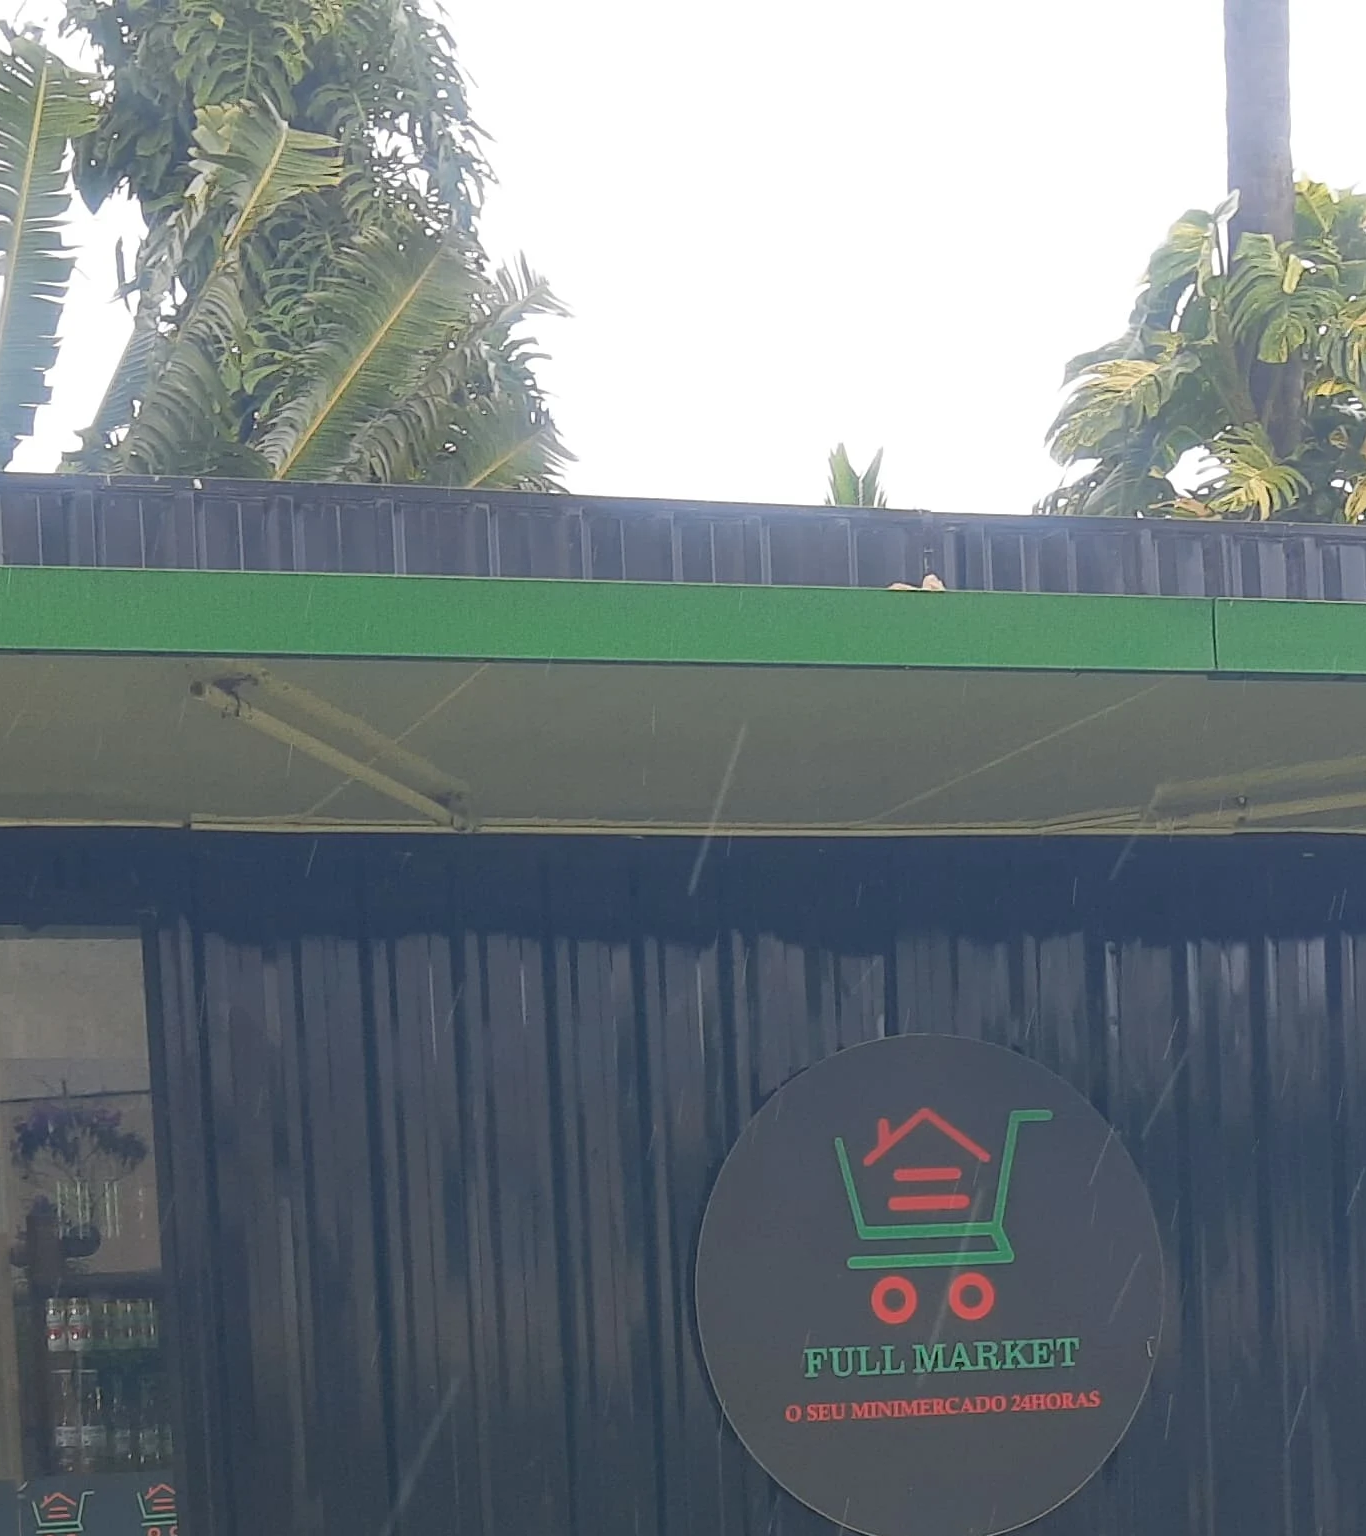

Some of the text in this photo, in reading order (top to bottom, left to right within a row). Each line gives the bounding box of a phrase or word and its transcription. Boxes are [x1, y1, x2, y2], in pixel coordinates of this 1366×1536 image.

[803, 1336, 1080, 1379] FULL MARKET
[785, 1390, 1102, 1422] O SEU MINIMERCADO 24HORAS
